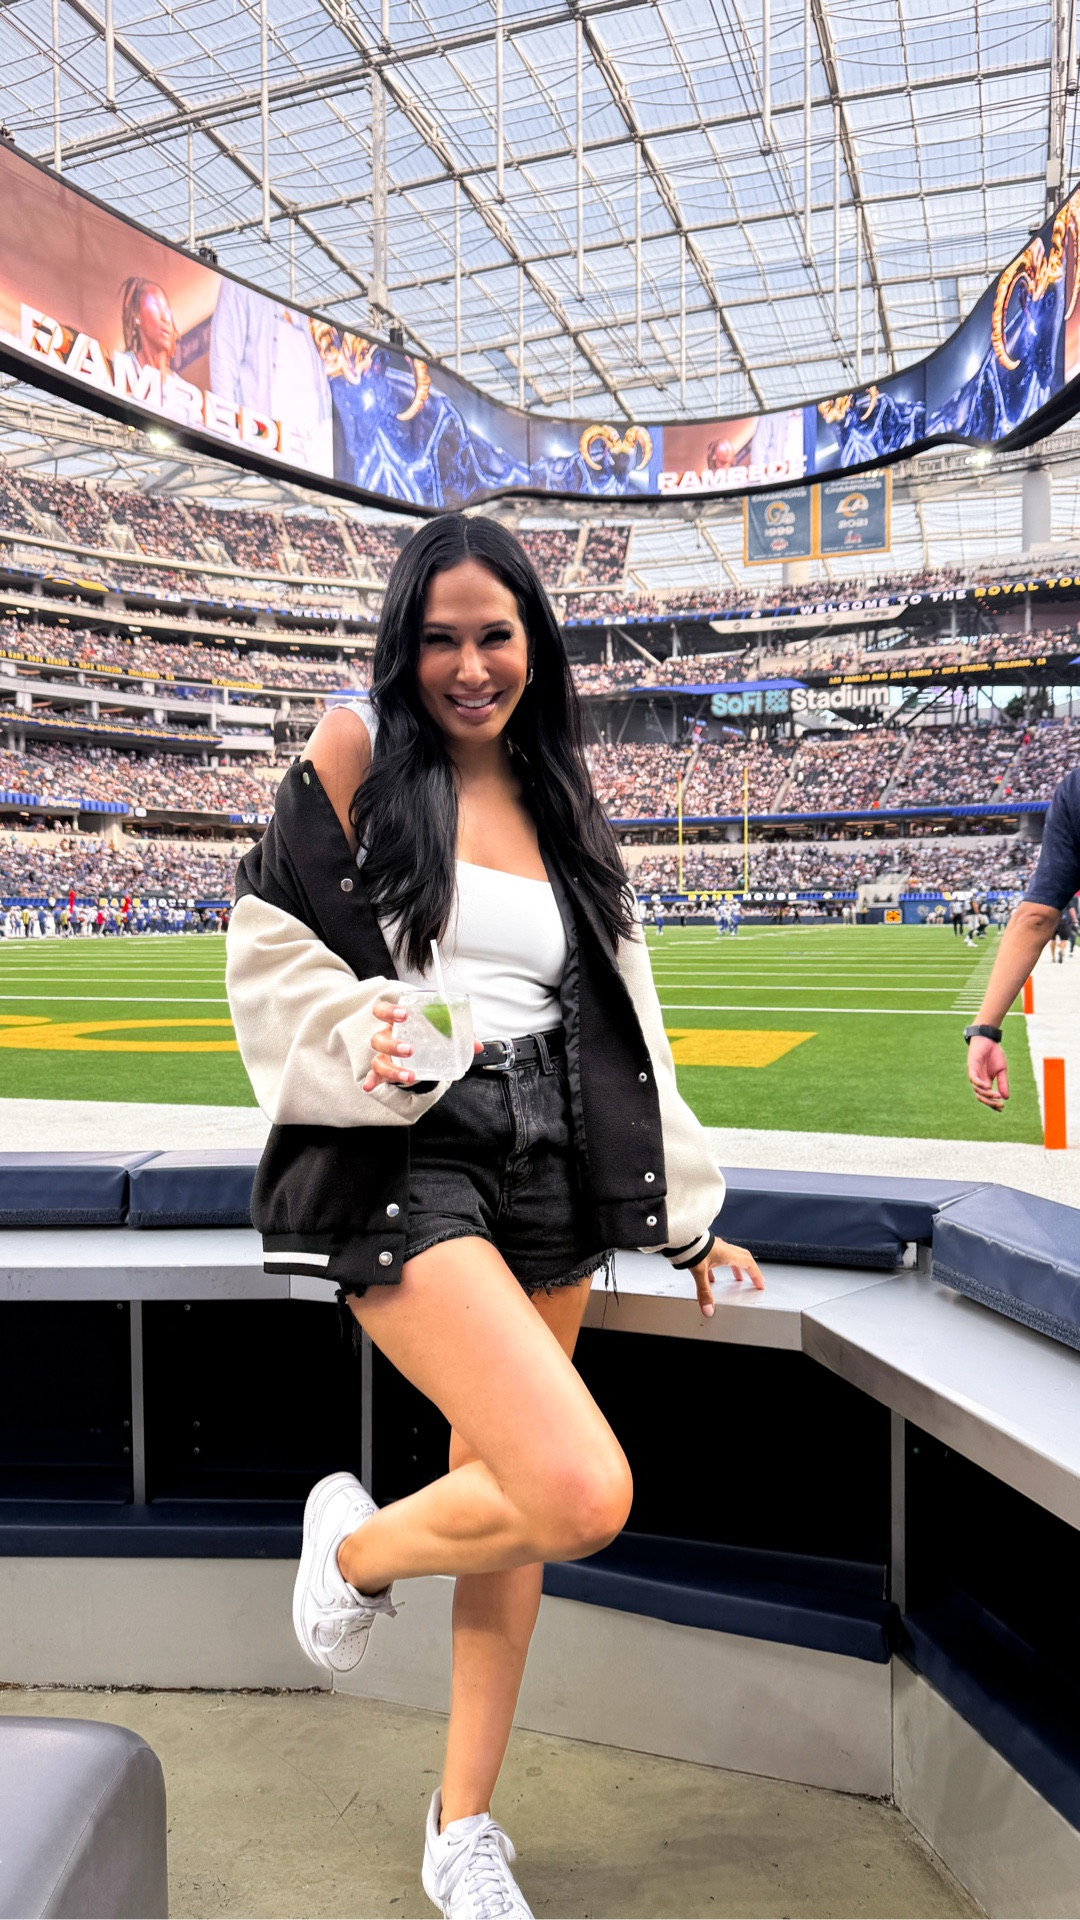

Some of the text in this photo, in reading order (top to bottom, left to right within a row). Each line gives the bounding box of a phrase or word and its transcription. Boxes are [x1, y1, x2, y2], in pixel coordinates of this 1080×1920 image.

[799, 598, 889, 615] WELCOME
[897, 594, 922, 605] TO
[929, 589, 967, 602] THE
[974, 581, 1039, 598] ROYAL
[711, 690, 762, 718] SoFi
[790, 684, 889, 711] Stadium
[241, 814, 272, 824] WE
[743, 892, 797, 901] HOUSE
